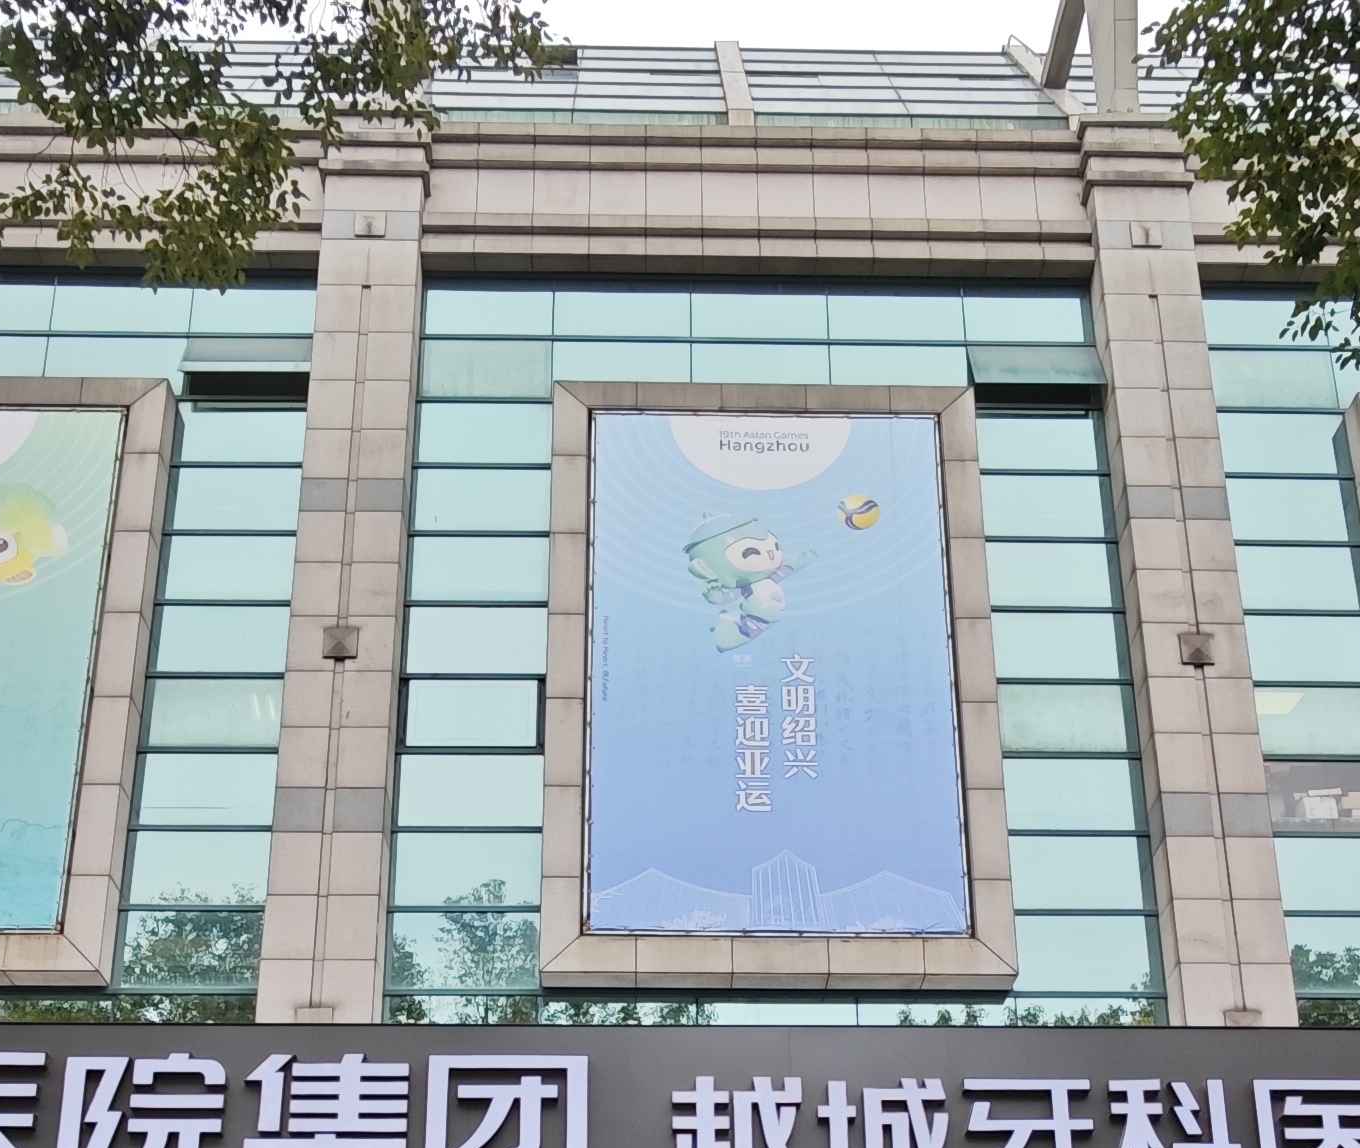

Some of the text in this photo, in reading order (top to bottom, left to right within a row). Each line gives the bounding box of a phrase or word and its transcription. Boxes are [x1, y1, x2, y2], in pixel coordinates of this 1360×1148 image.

[718, 430, 810, 440] 19th Asian Games
[719, 439, 810, 454] Hangzhou
[733, 684, 773, 813] 喜迎亚运
[779, 653, 819, 779] 文明绍兴
